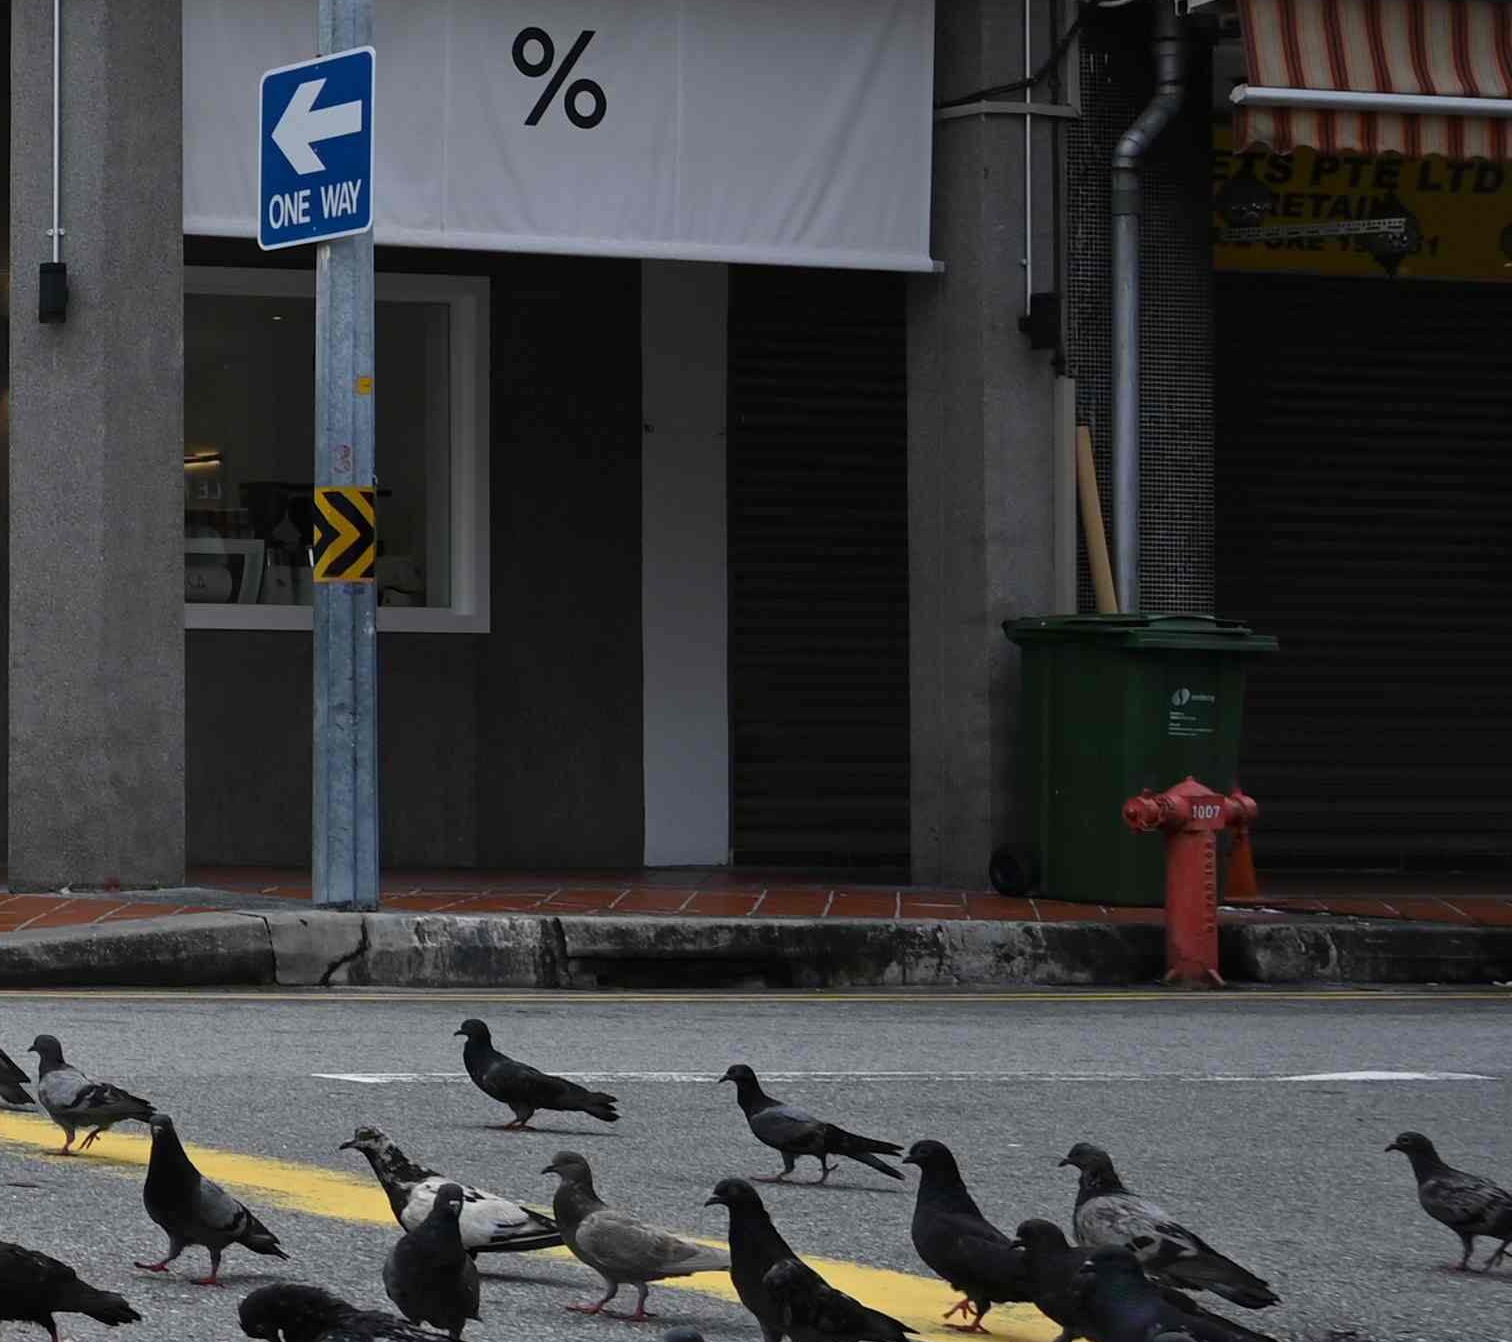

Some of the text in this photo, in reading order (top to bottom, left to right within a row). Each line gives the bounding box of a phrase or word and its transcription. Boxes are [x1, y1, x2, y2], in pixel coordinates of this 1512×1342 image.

[1417, 159, 1506, 193] LTD
[269, 178, 362, 229] ONE WAY
[1191, 805, 1221, 820] 1007
